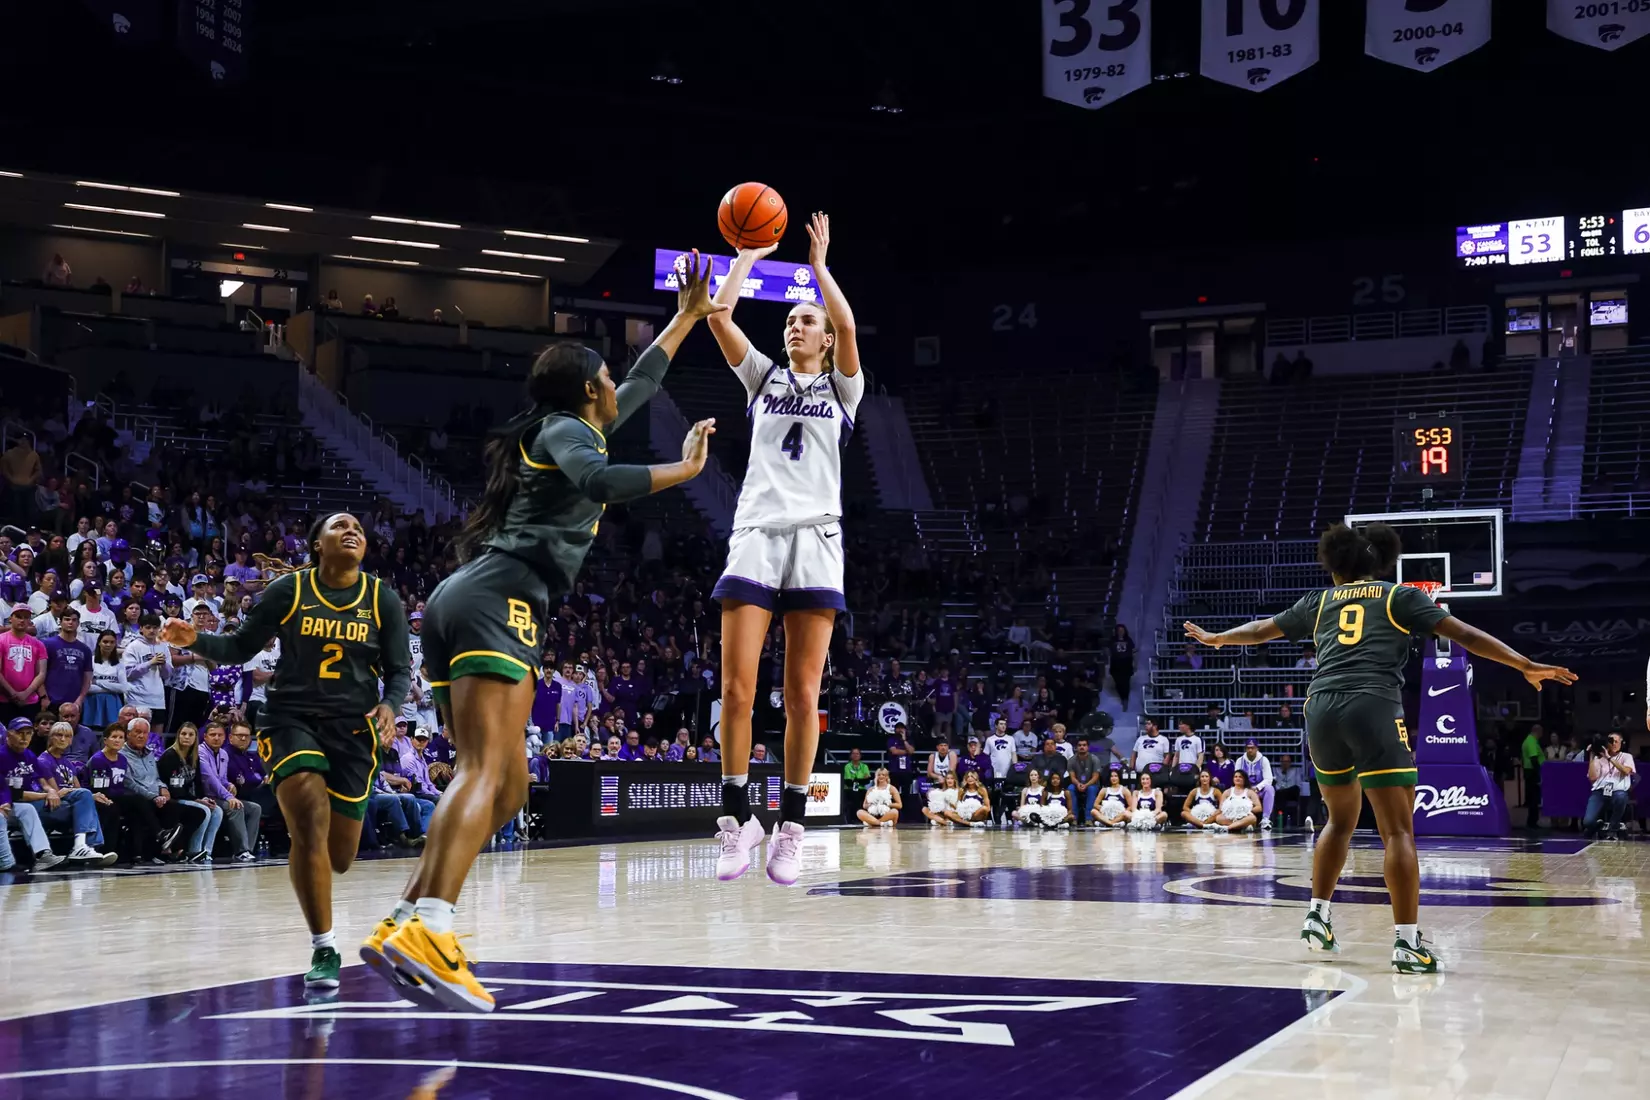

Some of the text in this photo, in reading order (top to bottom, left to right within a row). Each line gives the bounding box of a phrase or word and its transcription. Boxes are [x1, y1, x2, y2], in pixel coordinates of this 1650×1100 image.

[1574, 0, 1650, 19] 2001-05
[1050, 0, 1141, 57] 33
[1393, 22, 1464, 43] 2000-04
[1227, 44, 1293, 63] 1981-83
[1064, 64, 1125, 82] 1979-82
[1579, 215, 1605, 229] 5:53
[1520, 233, 1552, 255] 53
[1568, 236, 1616, 249] 3 TOL 4
[1634, 224, 1650, 244] 6
[1464, 256, 1488, 266] 7:40
[1489, 254, 1506, 264] PM
[1569, 246, 1616, 258] 1 FOULS 2
[1352, 273, 1406, 306] 25
[992, 302, 1039, 331] 24
[763, 394, 834, 419] Wildcats
[781, 421, 804, 461] 4
[1414, 427, 1452, 446] 5:53
[1421, 446, 1448, 475] 19
[1332, 585, 1383, 600] MATHARU
[300, 616, 369, 643] BAYLOR
[1337, 603, 1365, 645] 9
[318, 643, 344, 680] 2
[628, 782, 762, 808] SHELTER INSUCE
[1413, 785, 1489, 814] Dillons
